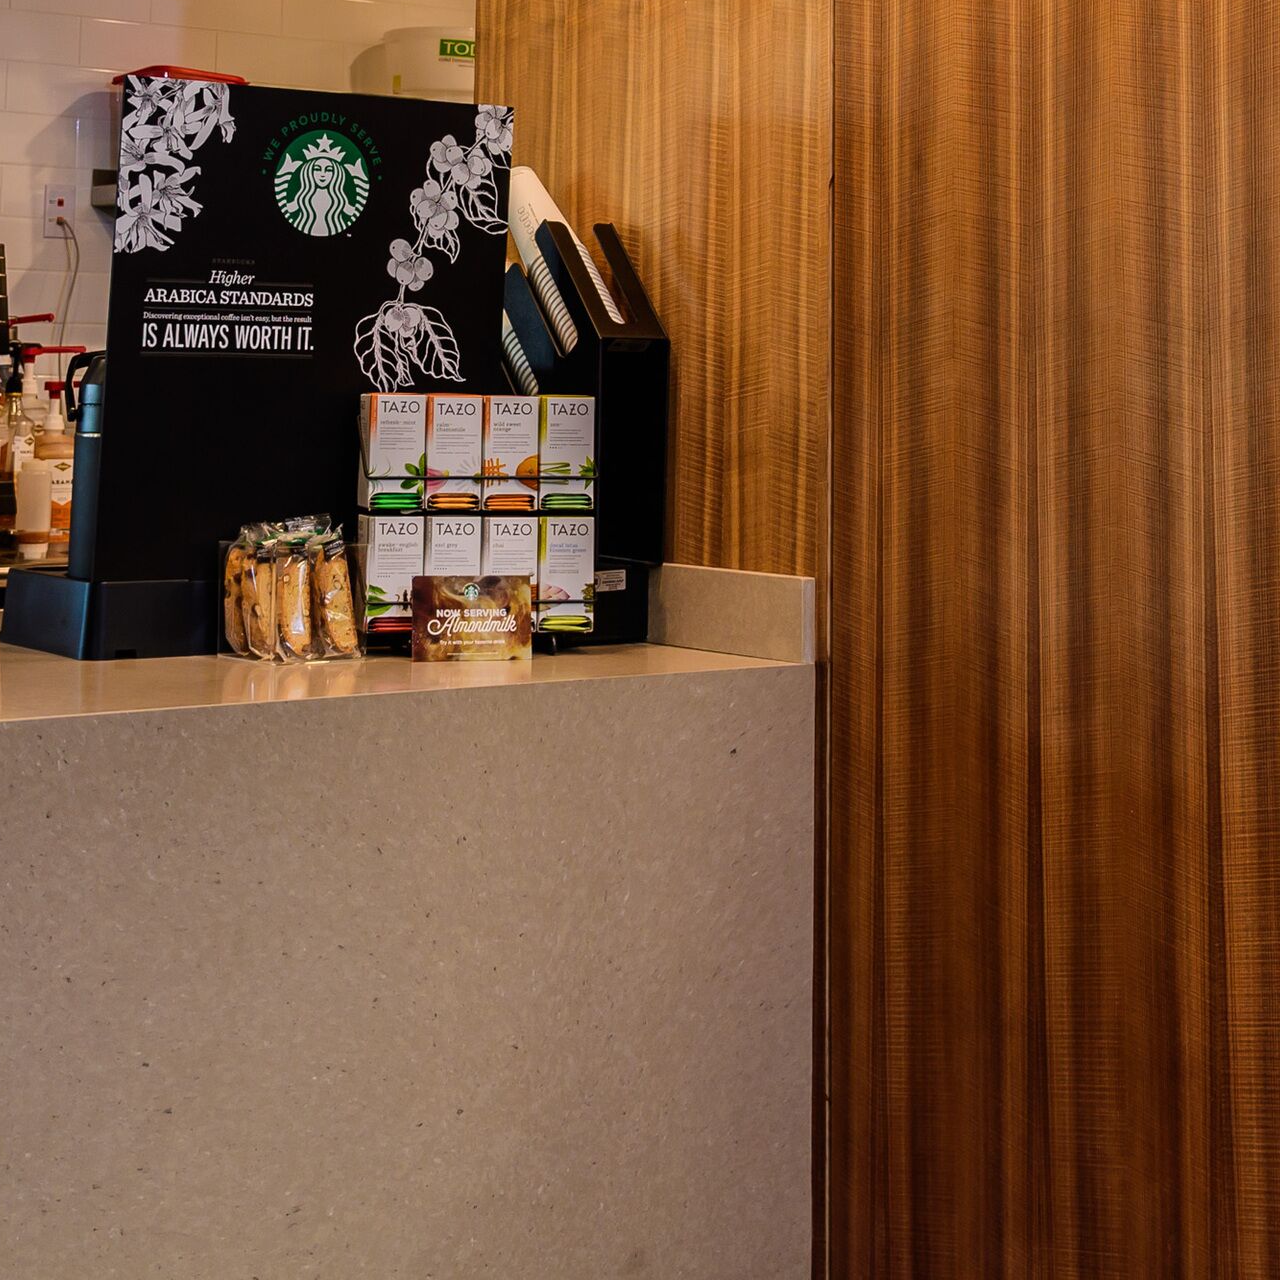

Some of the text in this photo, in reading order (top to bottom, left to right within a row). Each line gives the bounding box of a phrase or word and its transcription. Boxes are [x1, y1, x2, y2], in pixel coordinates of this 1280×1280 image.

[263, 112, 383, 167] WE PROUDLY SERVE
[209, 271, 255, 287] Higher
[144, 288, 314, 307] ARABICA STANDARDS
[143, 311, 182, 321] Discovering
[183, 313, 220, 322] exceptional
[241, 314, 255, 322] isn't
[256, 315, 271, 324] easy,
[142, 323, 314, 351] IS ALWAYS WORTH IT.
[381, 401, 420, 414] TAZO
[437, 403, 476, 416] TAZO
[493, 403, 533, 415] TAZO
[550, 403, 589, 416] TAZO
[379, 522, 418, 536] TAZO
[435, 522, 475, 536] TAZO
[493, 523, 533, 536] TAZO
[550, 524, 589, 536] TAZO
[436, 608, 507, 618] NOW SERVING
[427, 613, 517, 636] Almondmilk
